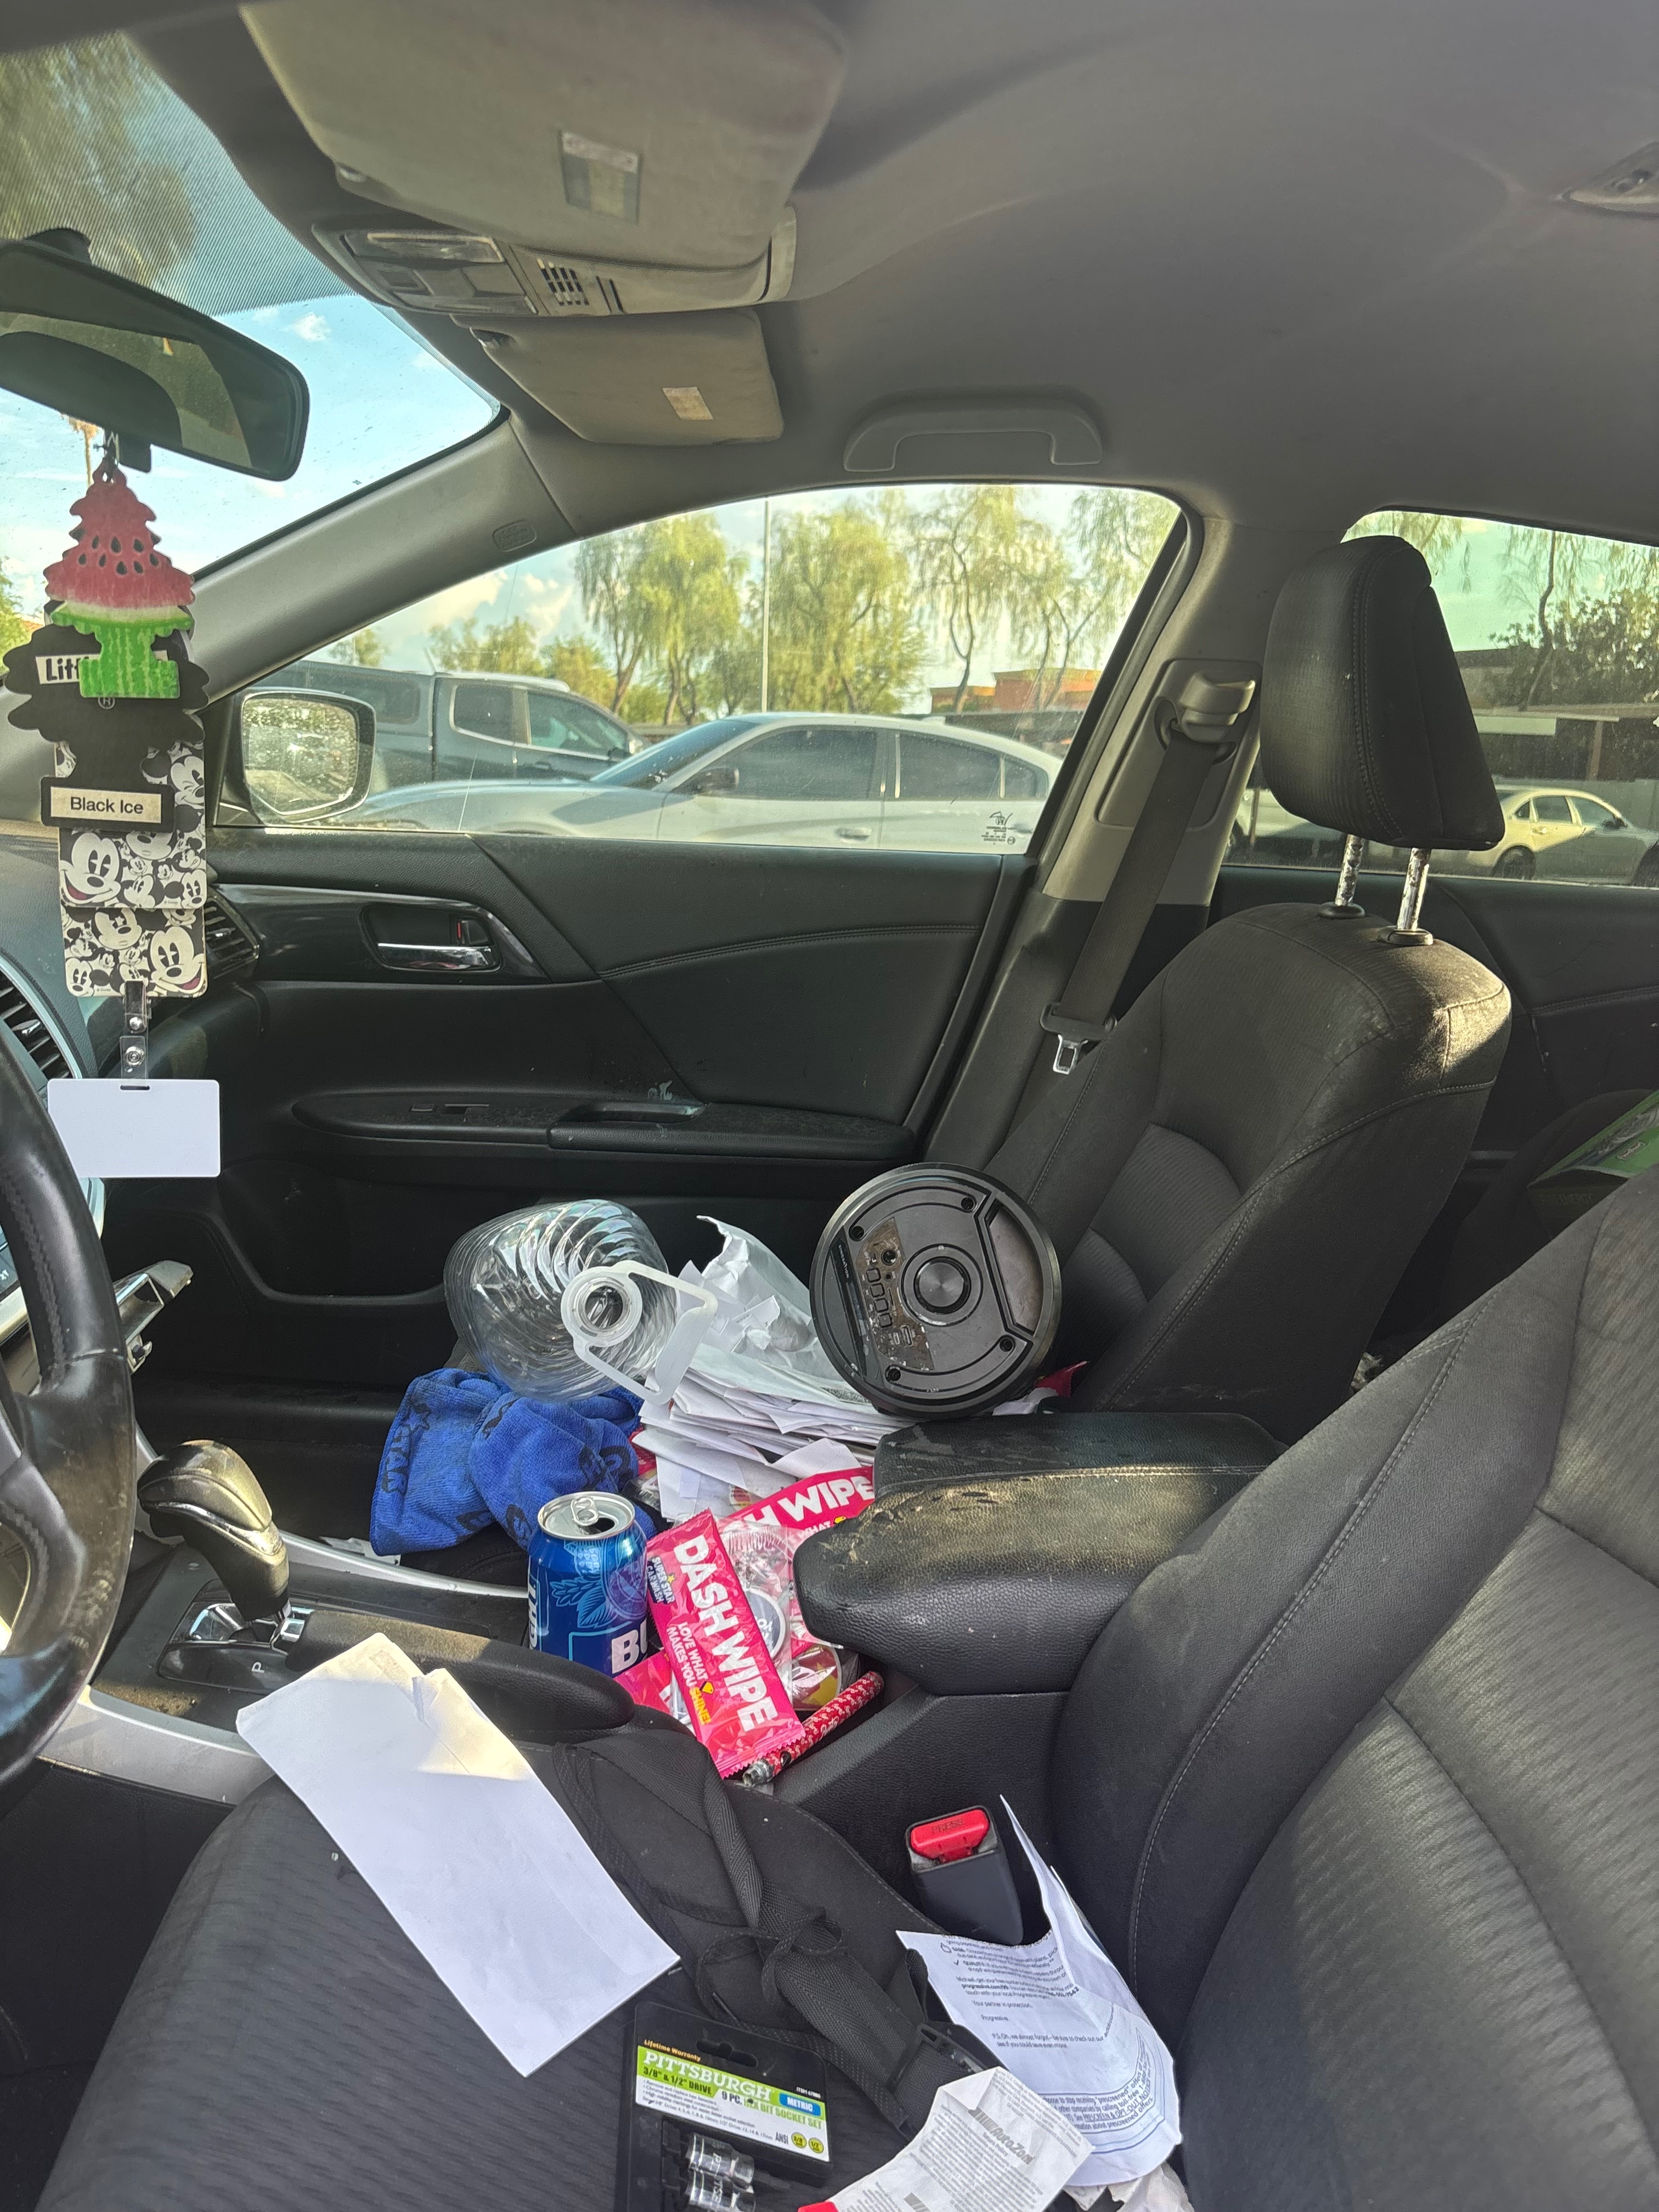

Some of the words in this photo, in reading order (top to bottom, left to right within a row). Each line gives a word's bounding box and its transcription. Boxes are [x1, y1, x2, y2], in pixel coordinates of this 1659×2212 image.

[46, 656, 81, 681] Lit
[70, 796, 115, 813] Black
[120, 799, 144, 814] Ice
[777, 1475, 876, 1522] WIPE
[647, 1565, 665, 1603] CARWASH
[652, 1556, 668, 1582] SUPER
[662, 1581, 675, 1604] STAR
[673, 1534, 739, 1637] DASH
[712, 1630, 778, 1732] WIPE
[666, 1627, 688, 1663] MAKES
[681, 1661, 698, 1688] YOU
[678, 1622, 696, 1649] LOVE
[688, 1648, 709, 1680] WHAT
[251, 1661, 265, 1673] P
[931, 1818, 964, 1833] PRESS
[644, 2039, 670, 2052] Lifetime
[672, 2047, 701, 2062] Warranty
[643, 2050, 772, 2101] PITTSBURGH
[644, 2066, 662, 2078] 3/8"
[671, 2076, 687, 2086] 1/2"
[689, 2080, 712, 2095] DRIVE
[1131, 2072, 1142, 2089] offers
[721, 2091, 728, 2101] 9
[729, 2093, 743, 2106] PC.
[760, 2103, 774, 2114] BIT
[775, 2106, 806, 2125] SOCKET
[808, 2117, 822, 2130] SET
[787, 2096, 813, 2112] METRIC
[1118, 2091, 1139, 2107] toll-free
[1107, 2110, 1139, 2129] prescreened
[775, 2131, 789, 2145] ANSI
